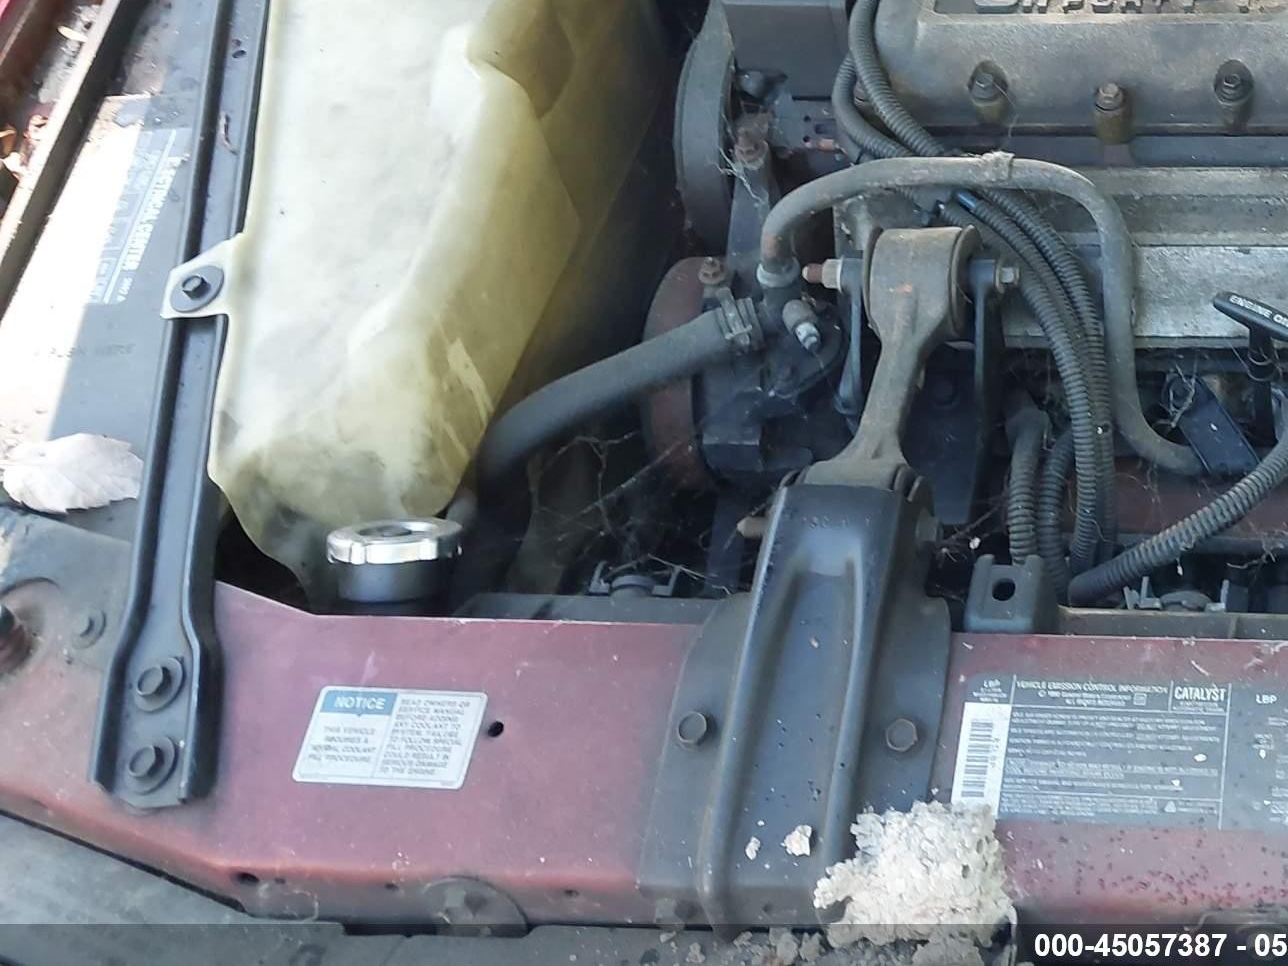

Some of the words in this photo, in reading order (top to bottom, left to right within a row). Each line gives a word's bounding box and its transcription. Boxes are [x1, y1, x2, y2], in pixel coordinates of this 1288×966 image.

[1229, 294, 1272, 319] ENGINE
[1083, 683, 1117, 692] CONTROL
[1174, 686, 1226, 701] CATALYST
[334, 696, 386, 710] NOTICE
[1256, 694, 1277, 704] LBP
